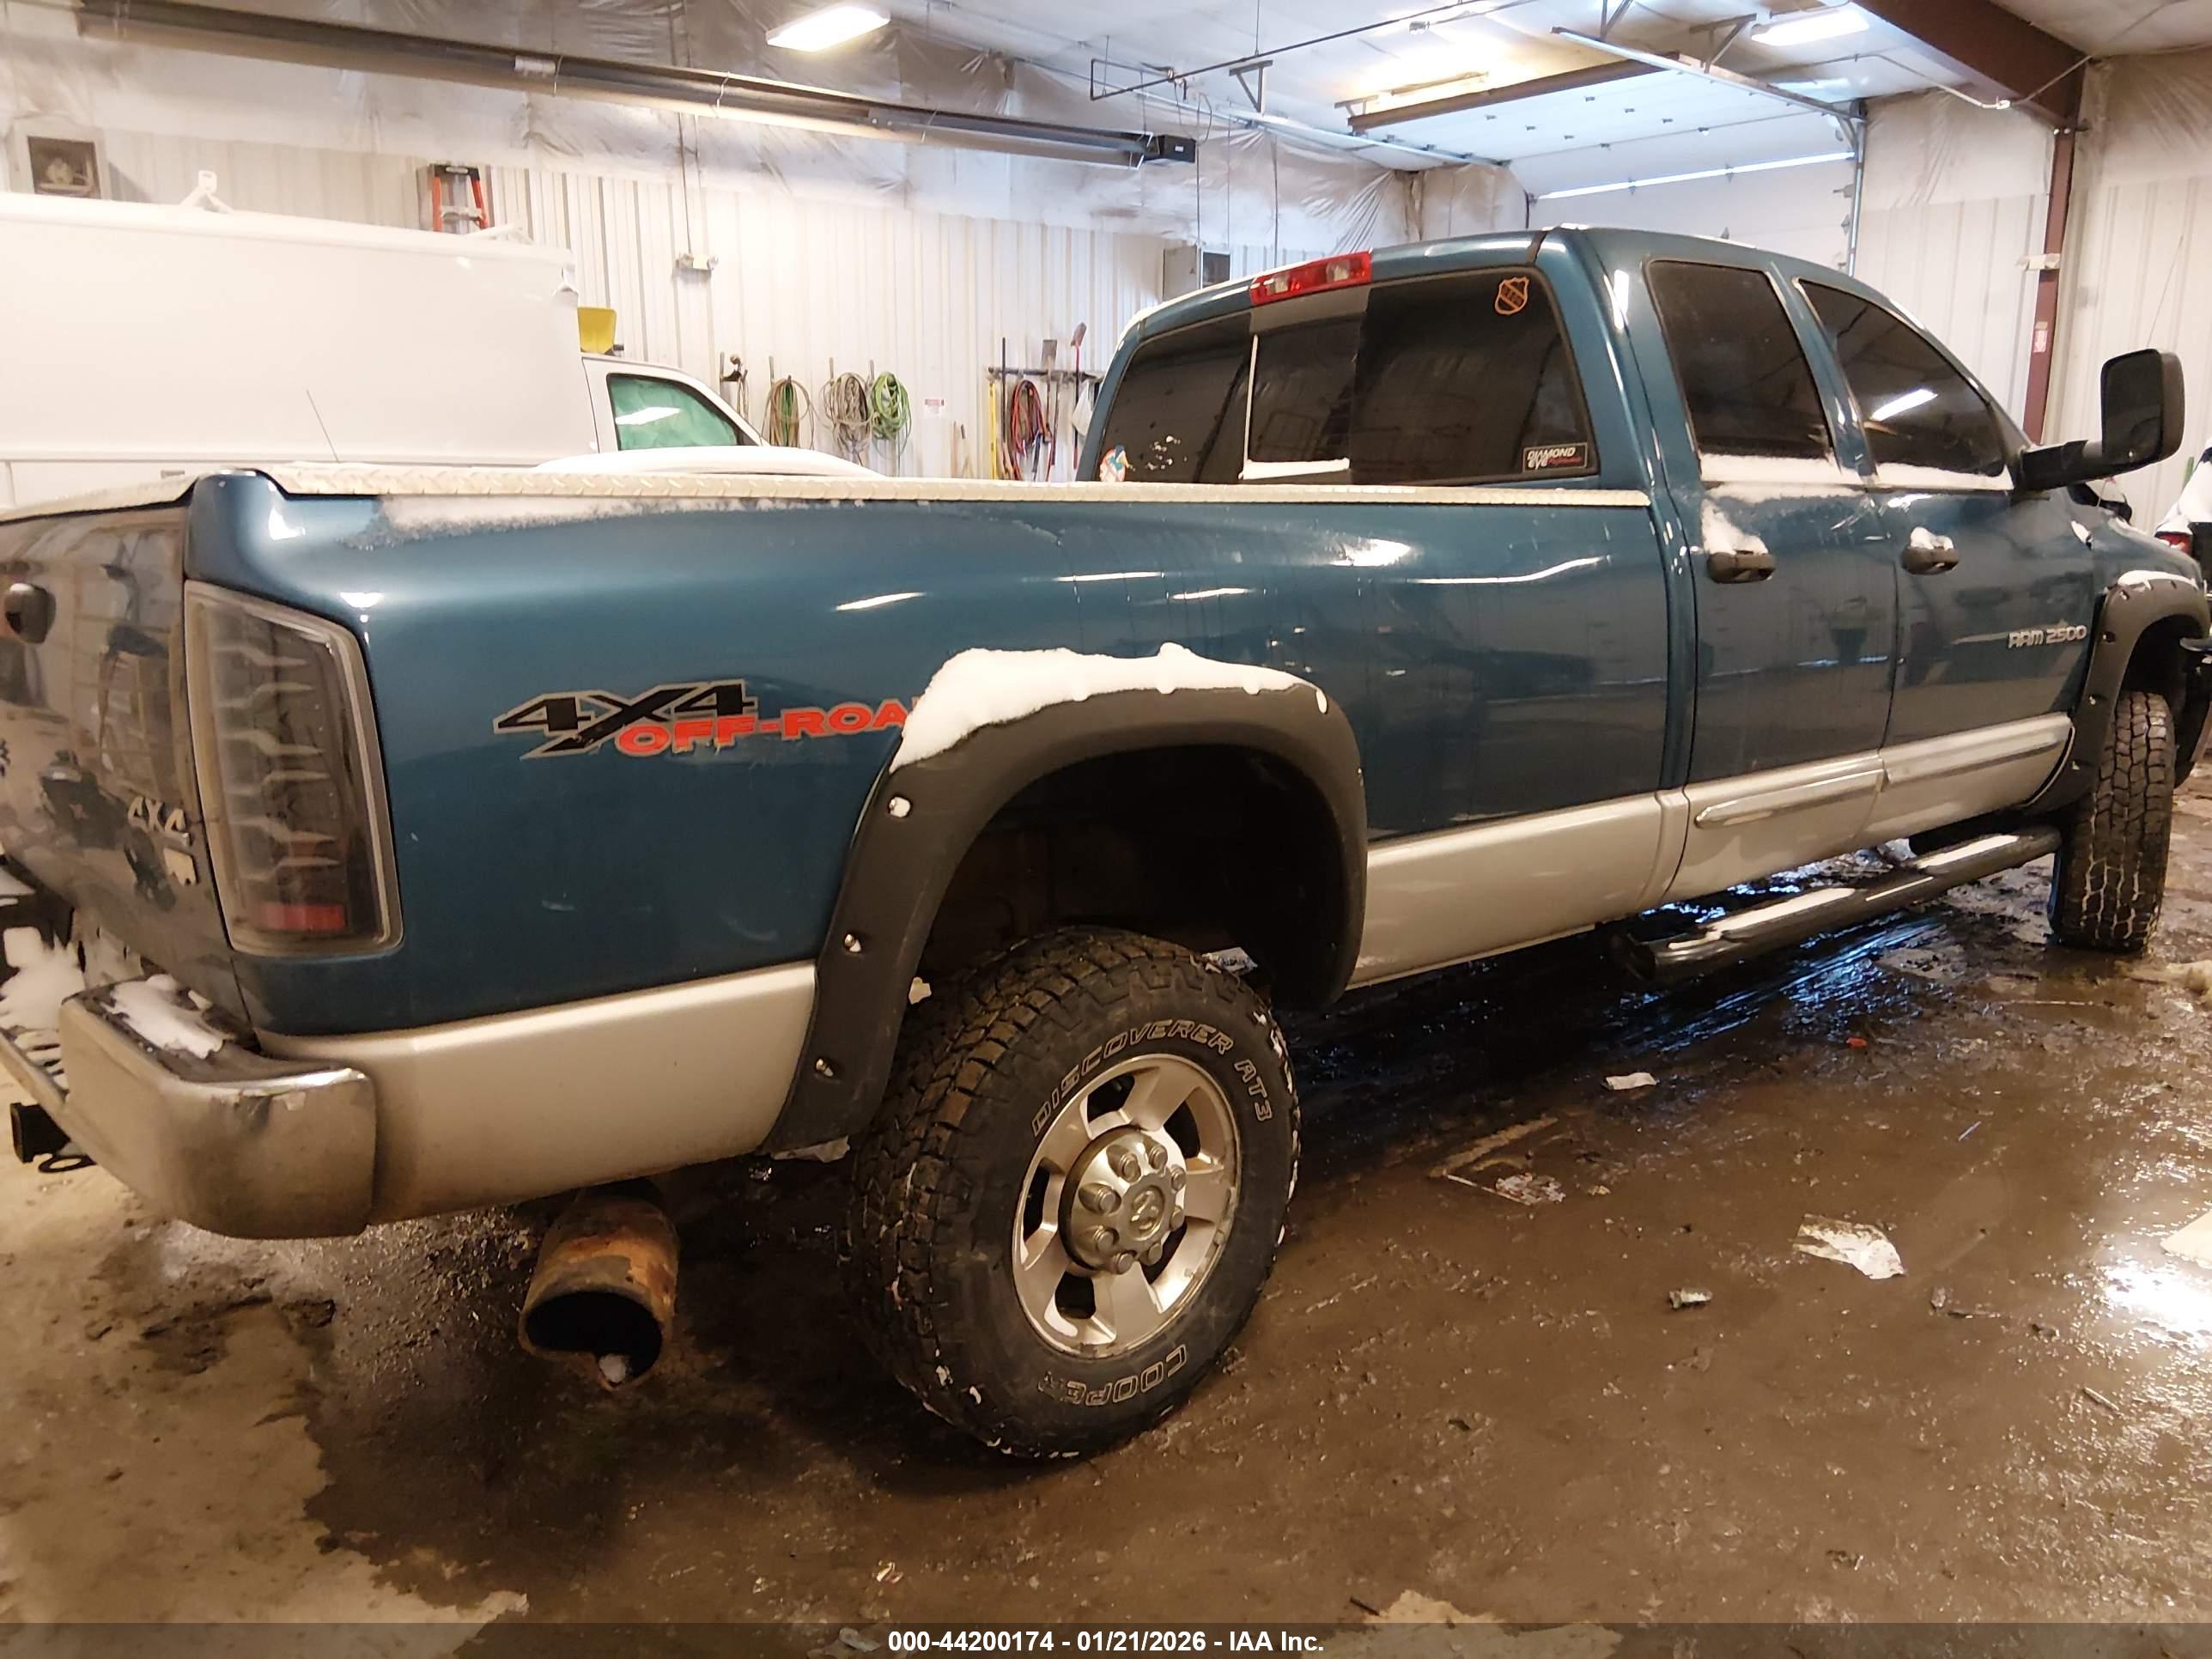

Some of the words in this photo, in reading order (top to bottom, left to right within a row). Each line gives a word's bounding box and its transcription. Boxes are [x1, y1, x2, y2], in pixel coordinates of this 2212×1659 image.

[1527, 447, 1577, 460] DIAMOND
[2008, 629, 2044, 649] RAM
[2045, 624, 2087, 644] 2500
[615, 697, 919, 757] OFF-ROA
[1031, 1018, 1235, 1138] DISCOVERER
[1234, 1059, 1273, 1122] AT3
